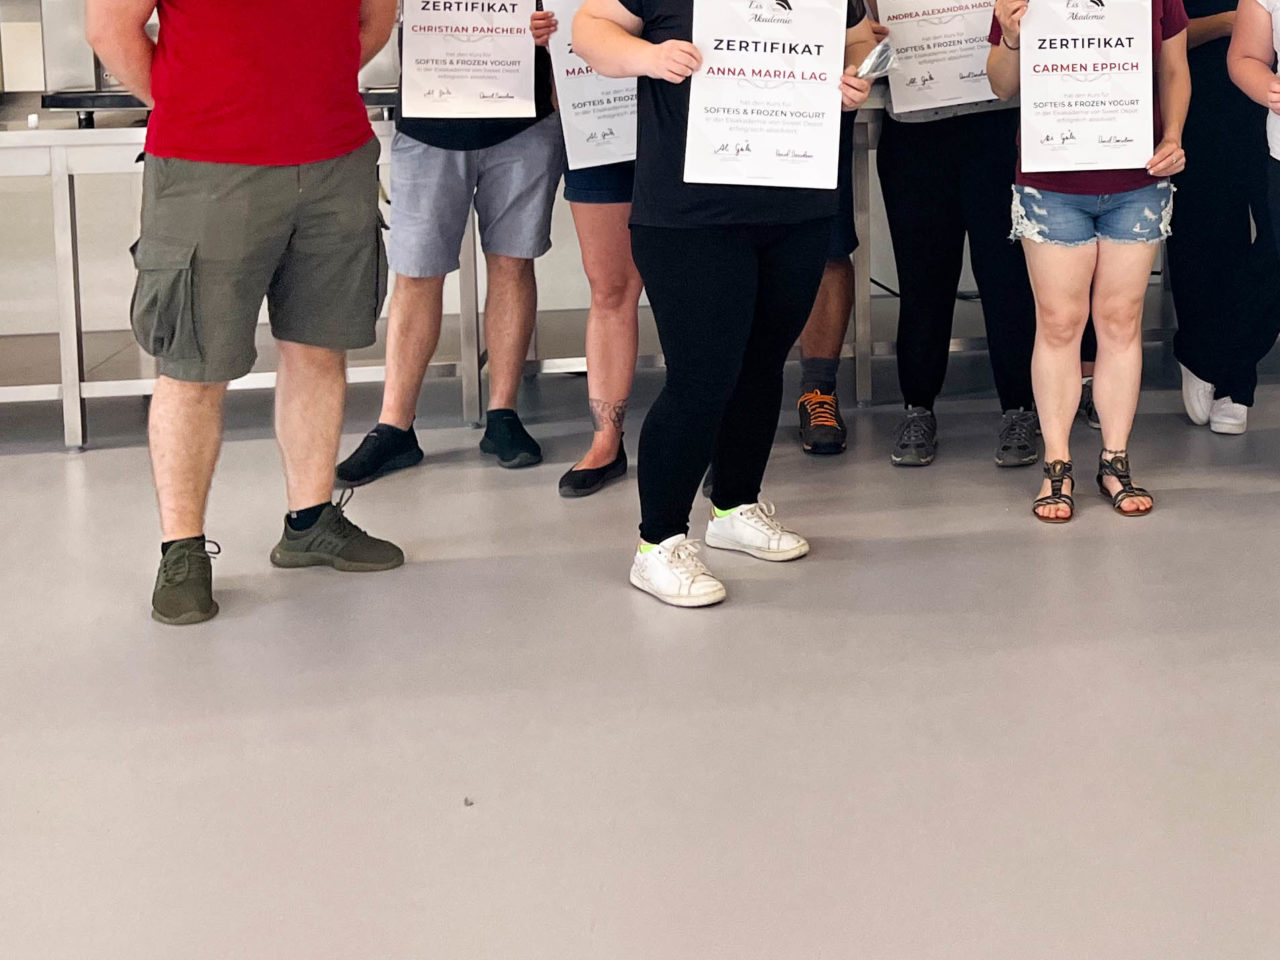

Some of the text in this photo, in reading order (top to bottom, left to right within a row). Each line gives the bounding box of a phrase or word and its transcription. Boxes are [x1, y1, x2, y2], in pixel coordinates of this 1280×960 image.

[421, 0, 518, 13] ZERTIFIKAT
[887, 10, 920, 22] ANDREA
[921, 4, 970, 16] ALEXANDRA
[412, 25, 526, 35] CHRISTIAN PANCHERI
[713, 39, 824, 56] ZERTIFIKAT
[895, 45, 925, 55] SOFTEIS
[933, 39, 962, 49] FROZEN
[1037, 37, 1135, 50] ZERTIFIKAT
[415, 58, 447, 66] SOFTEIS
[1033, 62, 1139, 73] CARMEN EPPICH
[565, 65, 593, 77] MAR
[706, 66, 827, 81] ANNA MARIA LAG
[571, 99, 605, 110] SOFTEIS
[704, 107, 740, 115] SOFTEIS
[751, 109, 787, 117] FROZEN
[790, 111, 826, 119] YOGURT
